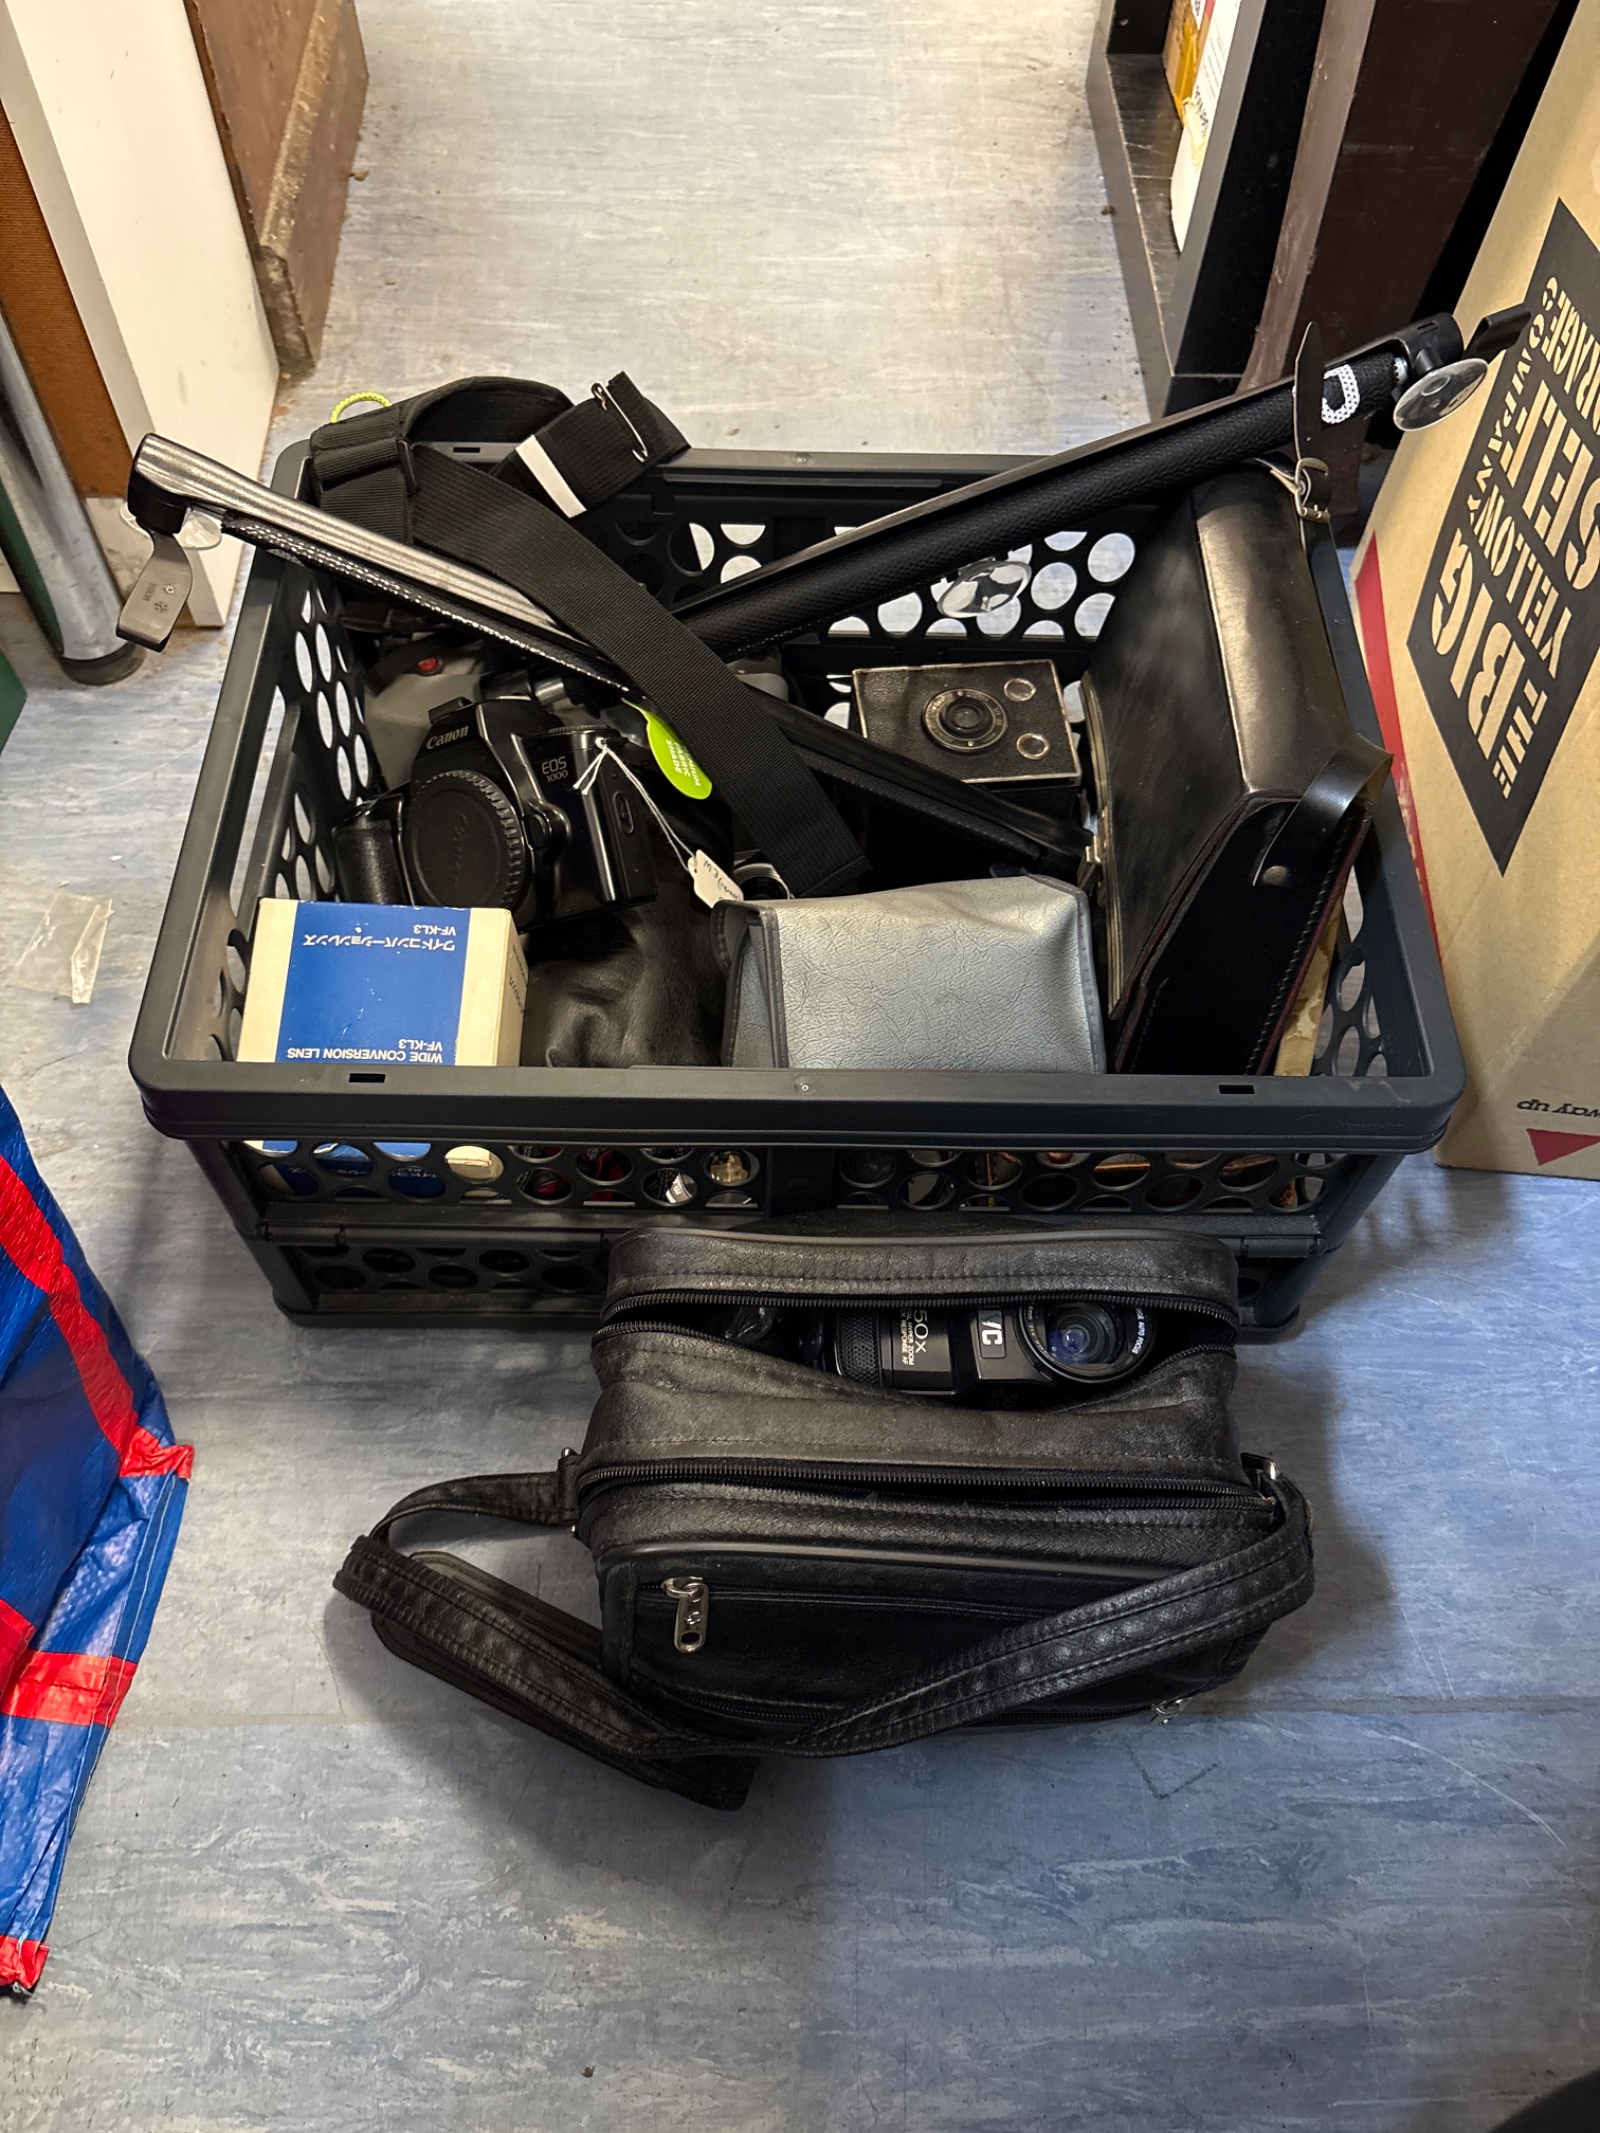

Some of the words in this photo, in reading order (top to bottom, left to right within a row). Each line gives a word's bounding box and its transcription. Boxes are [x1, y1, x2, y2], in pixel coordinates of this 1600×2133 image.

[1541, 290, 1600, 436] RAGE
[1467, 277, 1558, 526] COMPANY
[1500, 379, 1600, 590] SELF
[1473, 484, 1573, 680] YELLOW
[1431, 527, 1526, 760] BIG
[426, 725, 470, 750] Canon
[1491, 678, 1548, 800] THE
[541, 756, 568, 775] EOS
[666, 739, 683, 774] SHADE
[674, 742, 691, 777] FABRIC
[546, 769, 569, 783] 1000
[413, 924, 456, 936] VF-KL3
[286, 1047, 321, 1059] LENS
[398, 1038, 443, 1051] VF-KL3
[322, 1048, 407, 1062] CONVERSION
[409, 1051, 443, 1063] WIDE
[1516, 1099, 1550, 1112] up
[900, 1319, 908, 1353] RESPONSE
[1137, 1320, 1146, 1337] AUTO
[1131, 1336, 1144, 1355] FOCUS
[902, 1355, 909, 1365] AF
